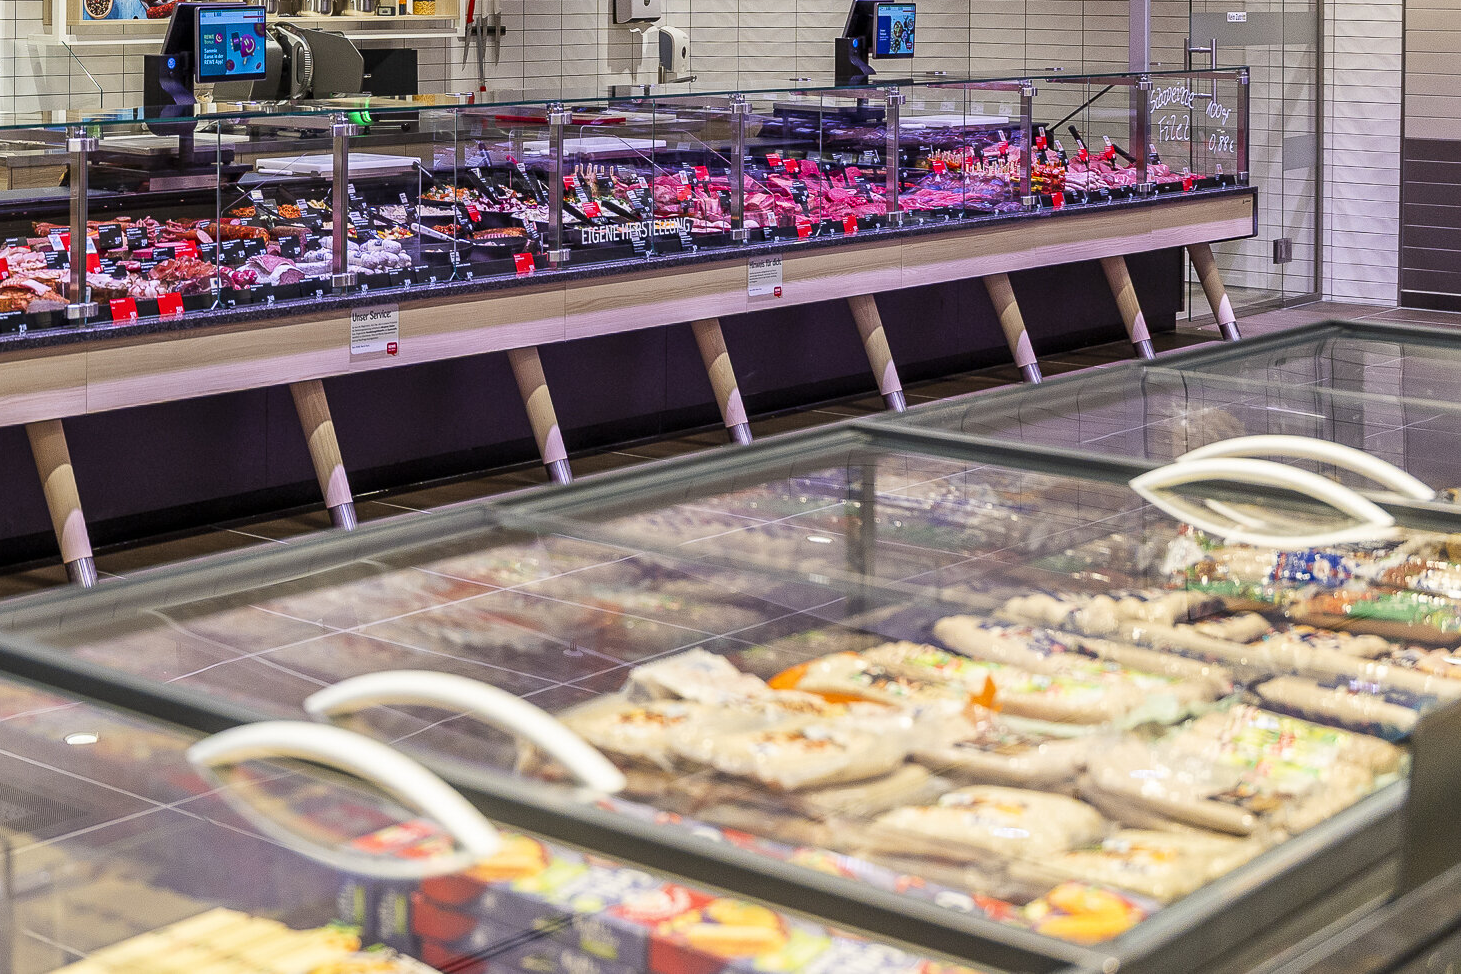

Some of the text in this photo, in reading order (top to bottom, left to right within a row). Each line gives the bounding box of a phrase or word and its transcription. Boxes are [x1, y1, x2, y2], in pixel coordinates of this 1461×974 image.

[581, 216, 691, 245] EIGENE HERSTELLUNG
[352, 312, 368, 322] Unser
